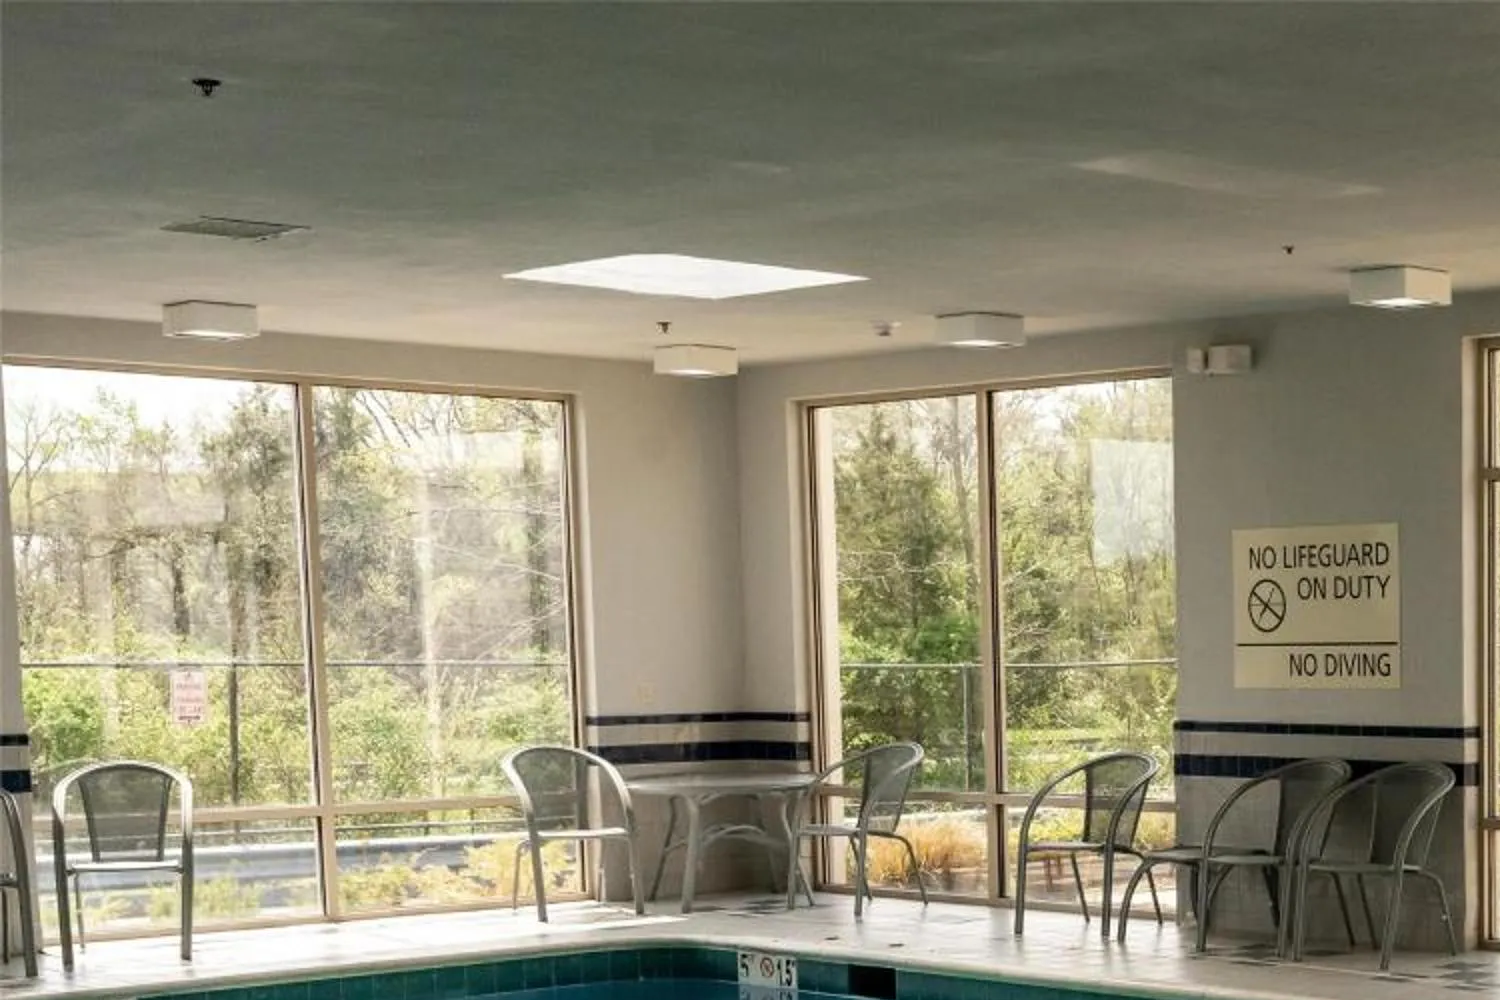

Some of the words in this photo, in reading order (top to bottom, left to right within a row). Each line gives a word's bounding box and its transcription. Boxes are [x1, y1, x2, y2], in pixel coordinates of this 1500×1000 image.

[1249, 545, 1277, 570] NO
[1283, 542, 1390, 569] LIFEGUARD
[1297, 576, 1327, 600] ON
[1333, 575, 1391, 599] DUTY
[1289, 652, 1318, 677] NO
[1324, 652, 1391, 677] DIVING
